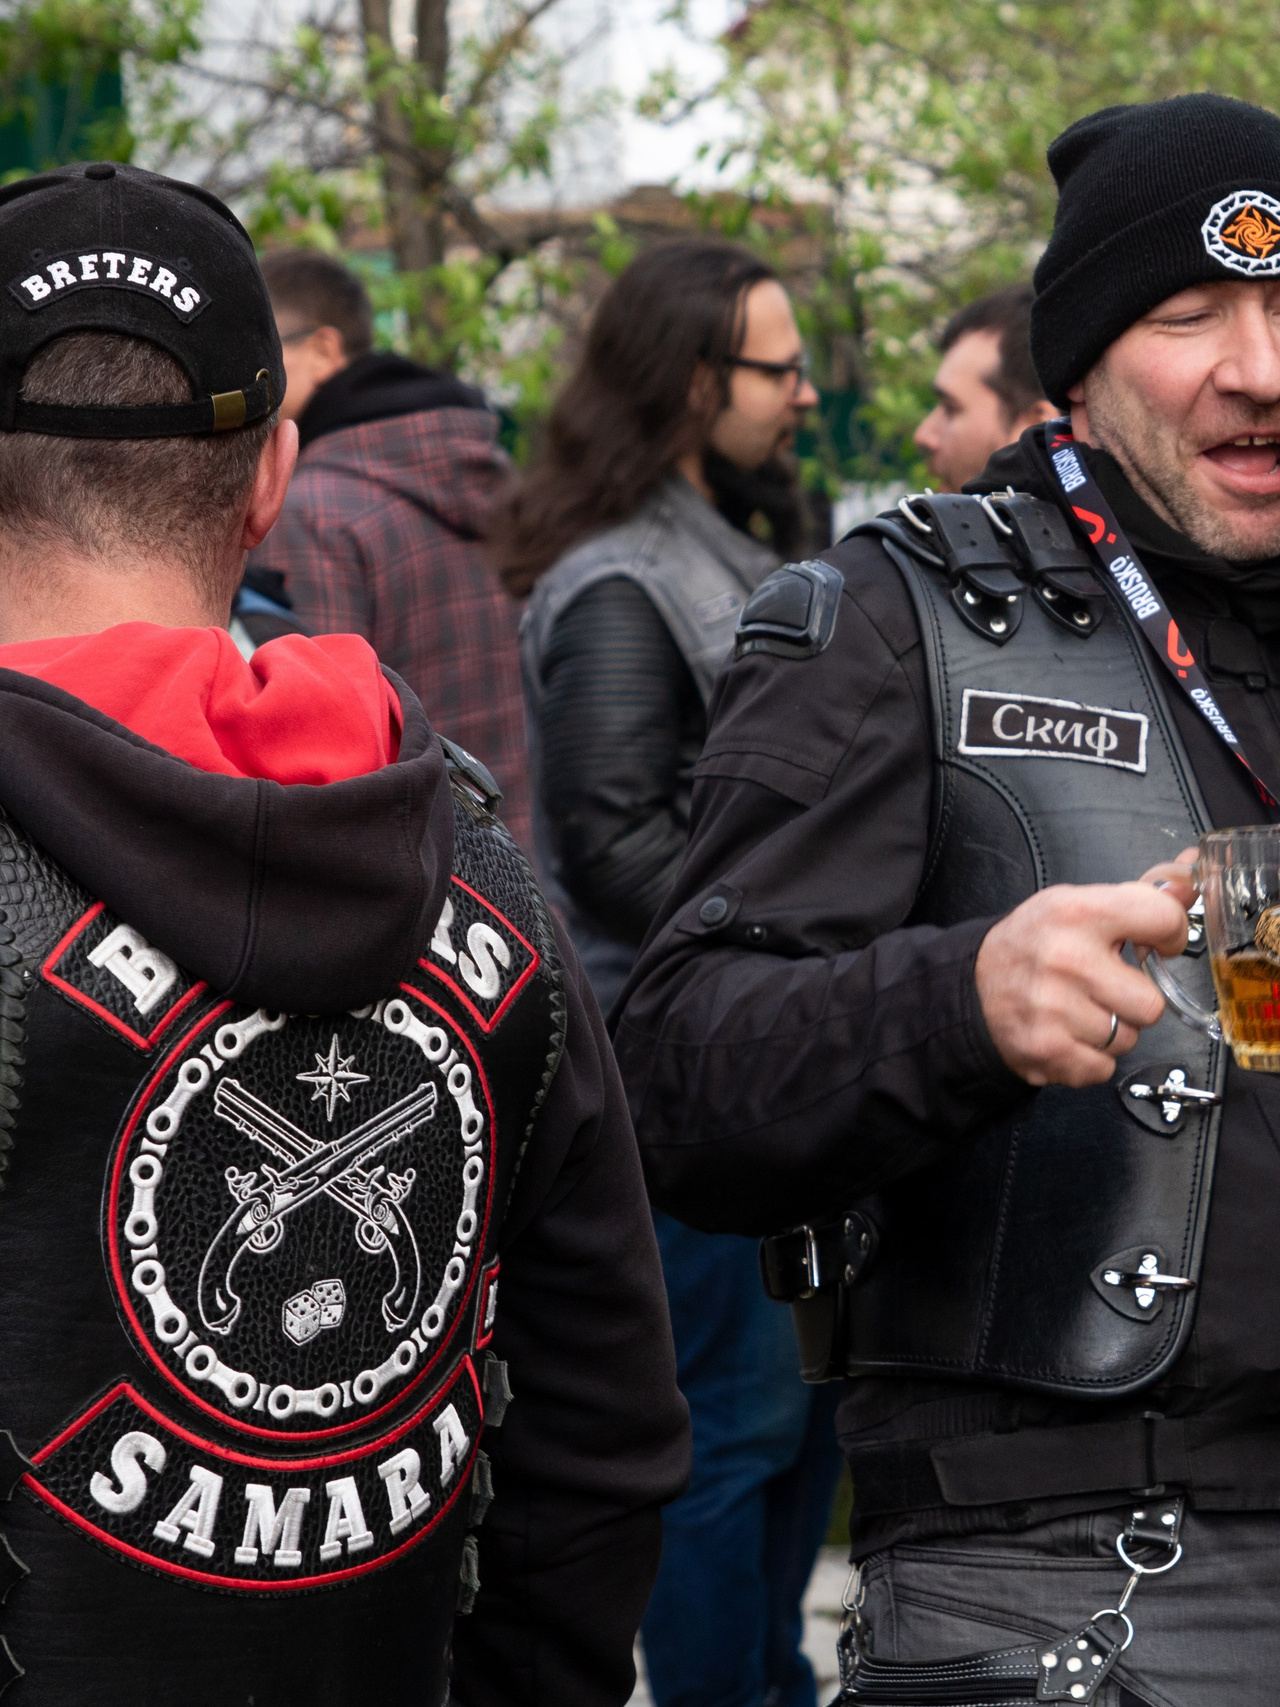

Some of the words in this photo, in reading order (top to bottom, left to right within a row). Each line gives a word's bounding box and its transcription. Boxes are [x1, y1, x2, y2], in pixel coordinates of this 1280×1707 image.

[21, 252, 200, 313] BRETERS
[992, 703, 1118, 757] Скиф
[90, 1403, 470, 1566] SAMARA
